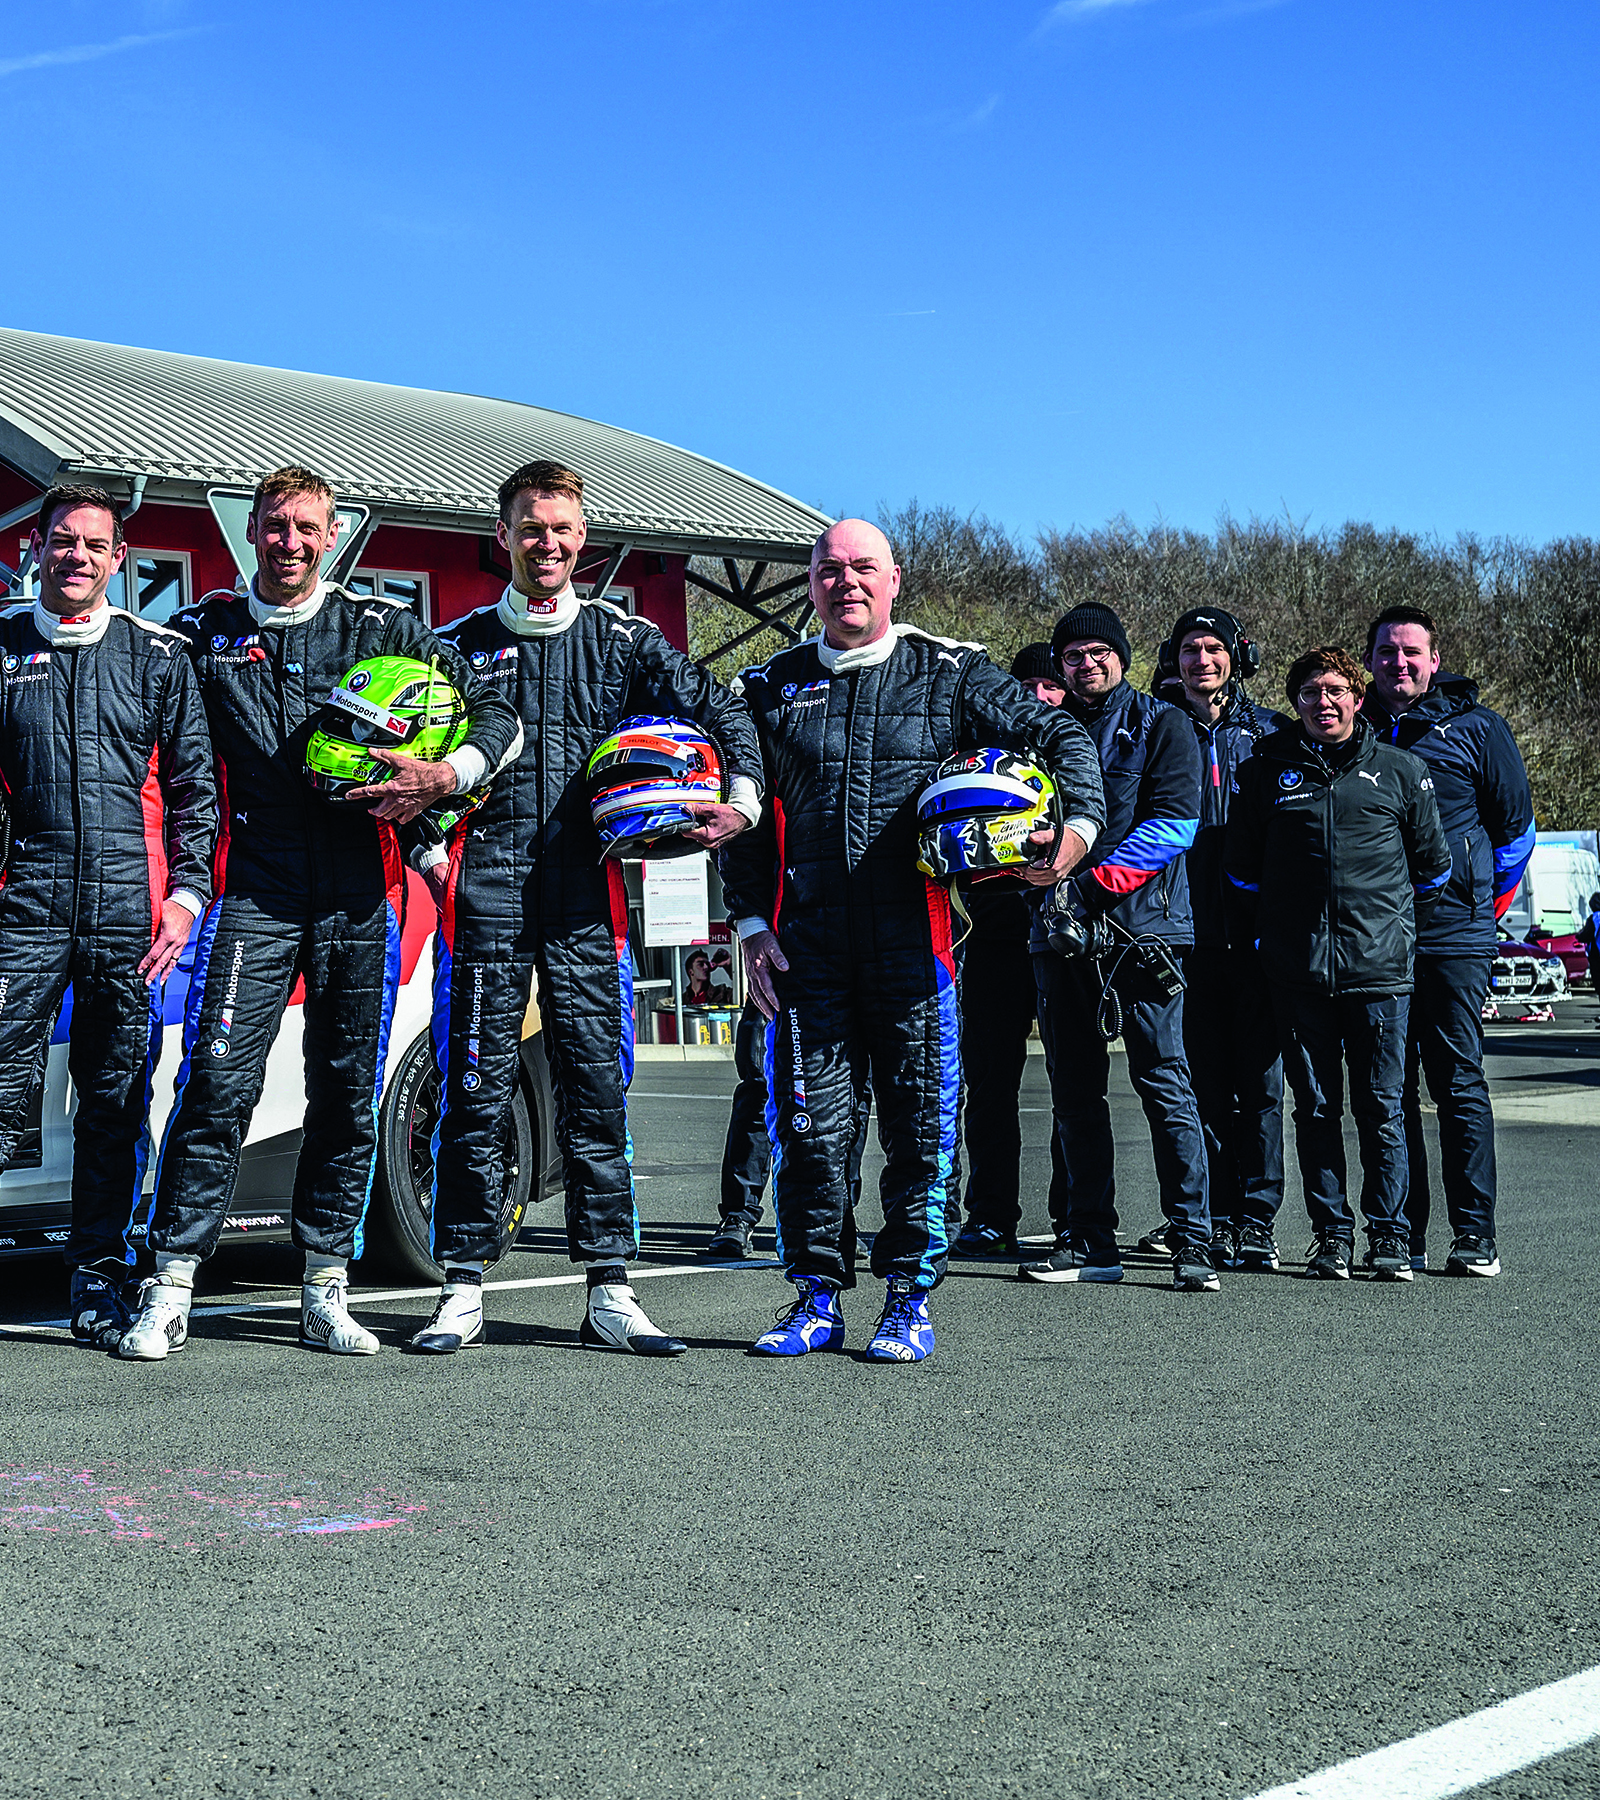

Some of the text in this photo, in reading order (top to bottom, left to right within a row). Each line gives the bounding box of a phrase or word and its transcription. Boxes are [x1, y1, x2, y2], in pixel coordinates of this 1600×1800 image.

[528, 604, 551, 613] PUMA
[213, 654, 250, 664] Motorspo
[6, 672, 49, 687] Motorsport
[334, 694, 379, 720] Motorsport
[786, 696, 827, 714] torsport
[628, 738, 660, 746] HUBLOT
[942, 758, 980, 776] Stilo
[706, 779, 720, 787] BELL
[224, 939, 245, 1006] Motorsport
[469, 967, 484, 1035] Motorsport
[788, 1007, 804, 1076] Motorsport
[228, 1214, 285, 1228] Motorsport
